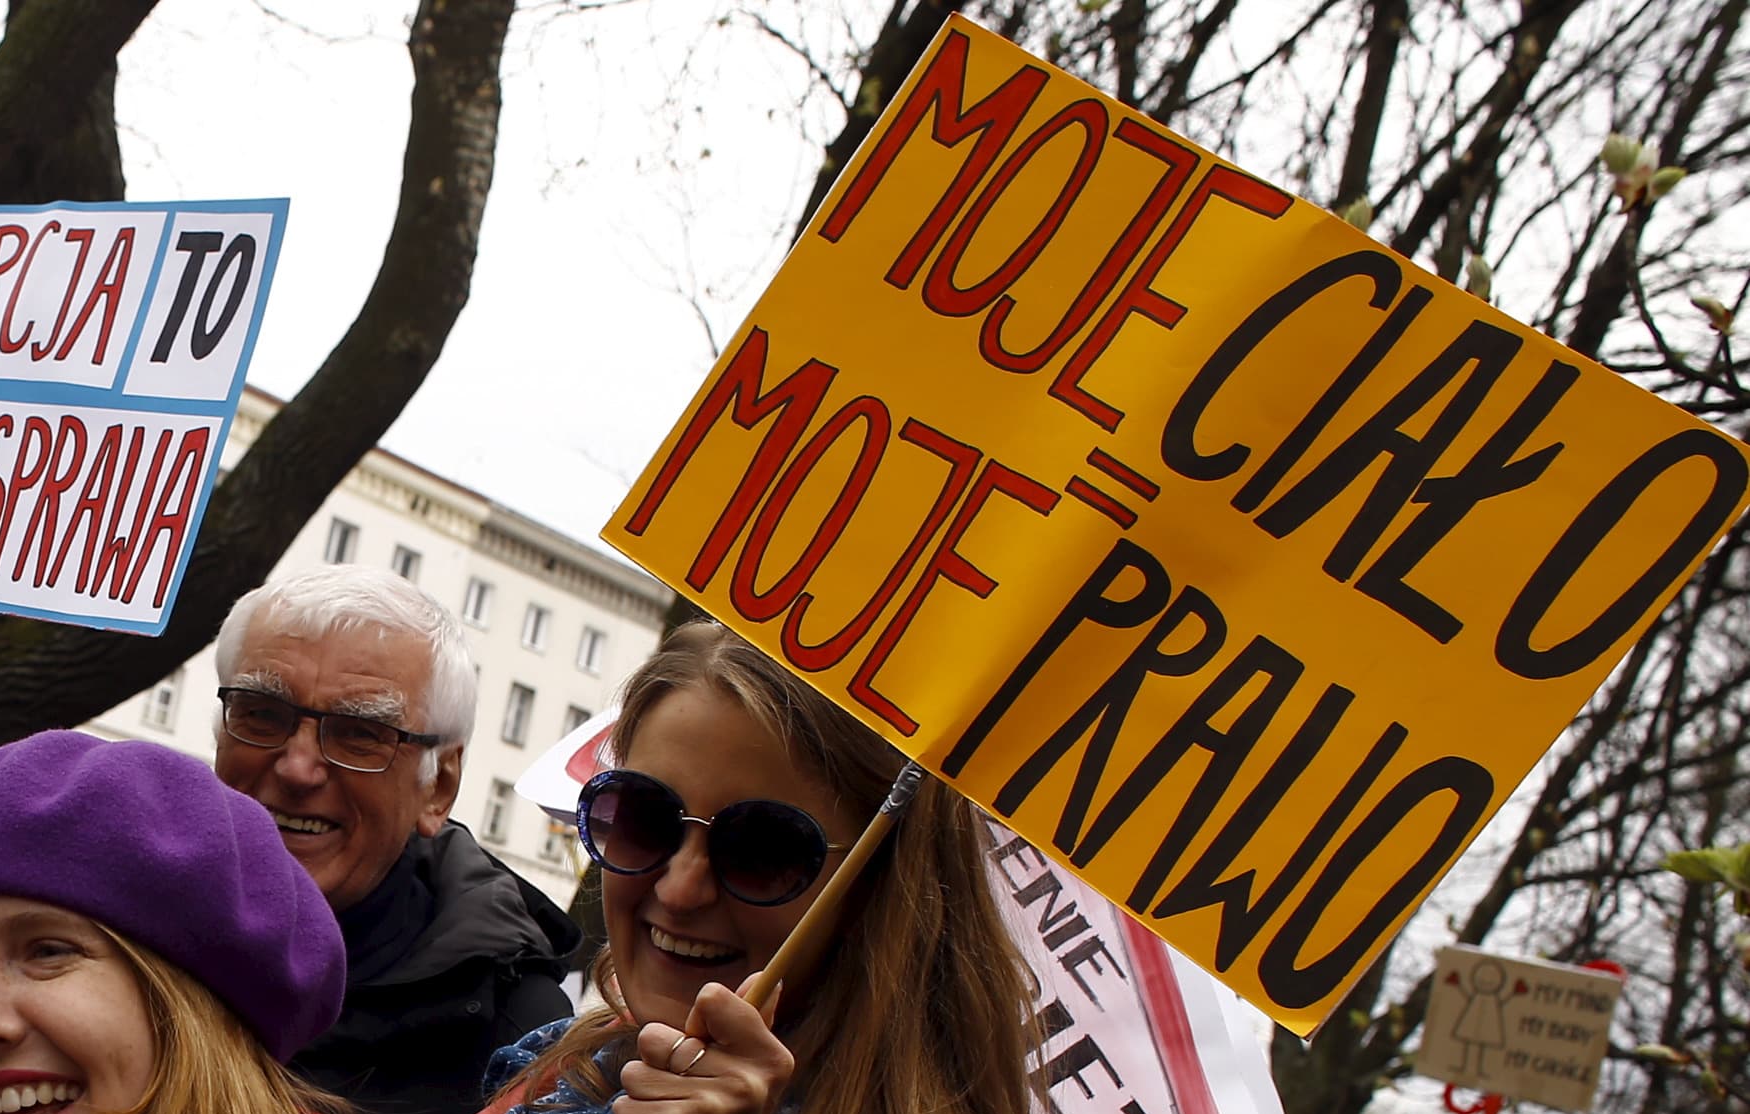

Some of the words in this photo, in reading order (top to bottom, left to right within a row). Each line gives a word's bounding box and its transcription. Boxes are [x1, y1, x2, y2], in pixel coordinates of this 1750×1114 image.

[148, 231, 256, 363] TO
[818, 29, 1295, 433] MOJE
[1158, 249, 1749, 681] CIAŁO
[624, 325, 1061, 736] MOJE
[941, 537, 1495, 1010] PRAWO
